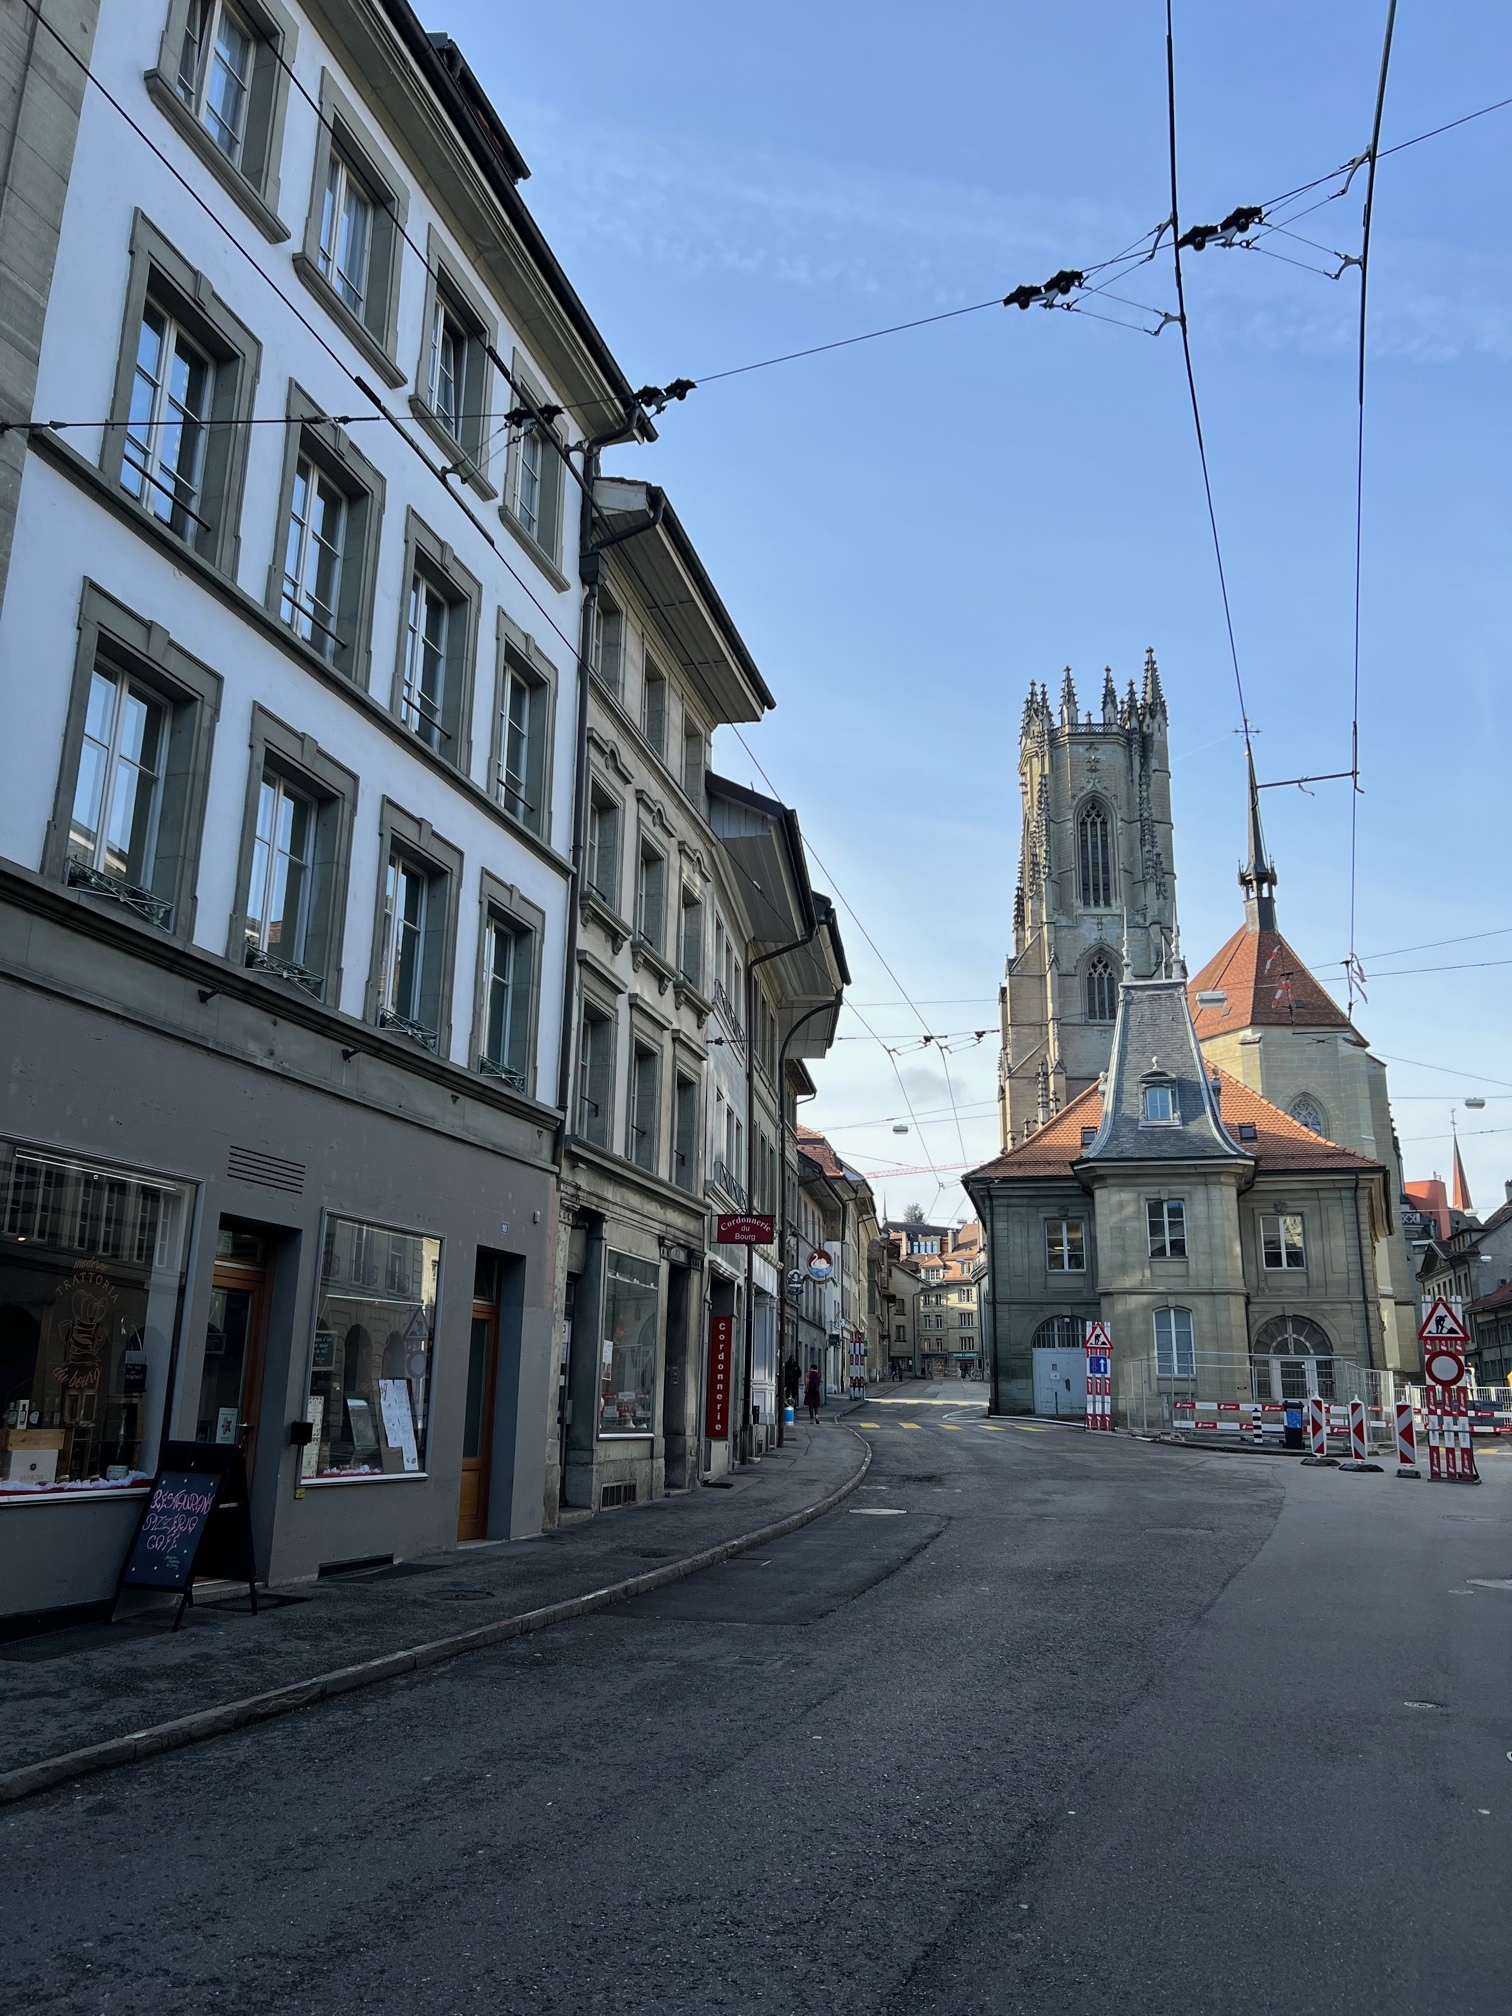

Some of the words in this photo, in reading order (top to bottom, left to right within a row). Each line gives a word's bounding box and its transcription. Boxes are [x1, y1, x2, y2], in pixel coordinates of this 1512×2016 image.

[720, 1216, 771, 1233] Cordonnerie
[735, 1233, 756, 1242] Bourg
[73, 1256, 109, 1272] moderne
[55, 1272, 119, 1304] TRATTORIA
[52, 1366, 70, 1384] du
[69, 1366, 102, 1392] bourg
[715, 1322, 726, 1431] Cordonnerie
[142, 1513, 199, 1534] PIZZERIA
